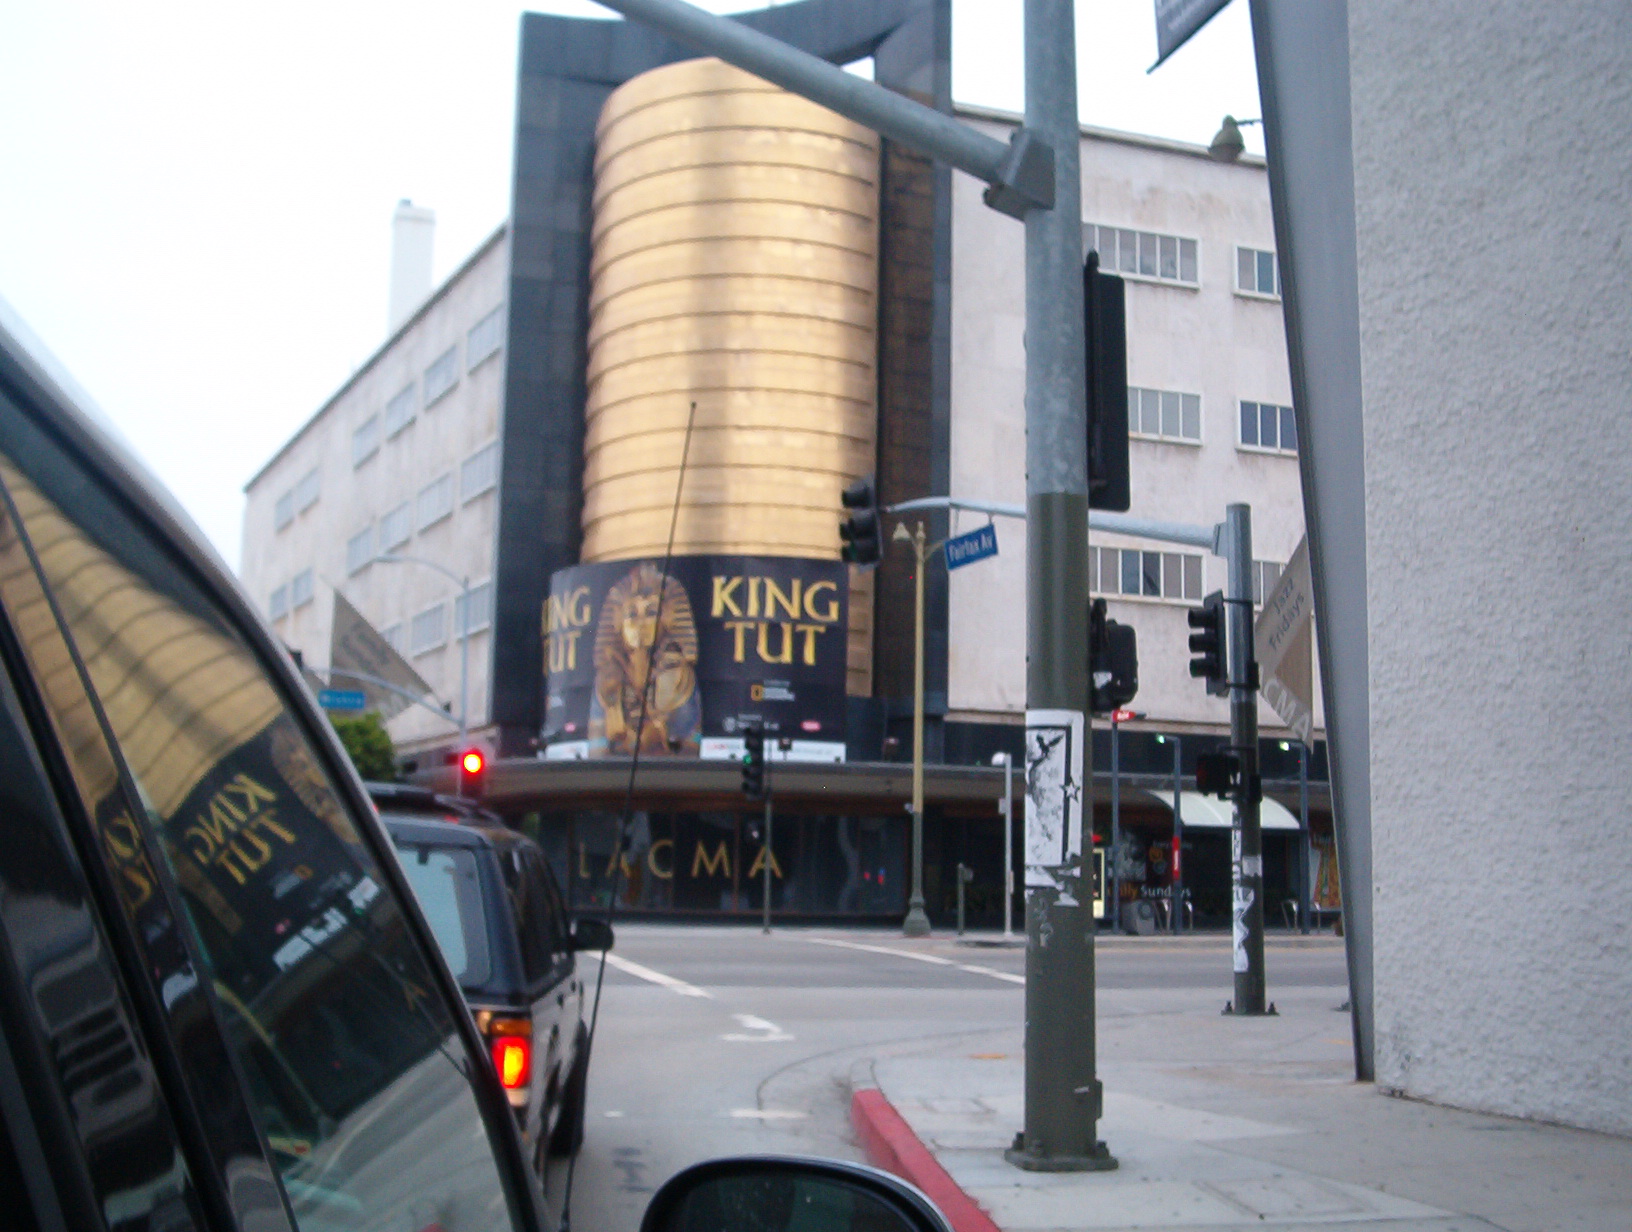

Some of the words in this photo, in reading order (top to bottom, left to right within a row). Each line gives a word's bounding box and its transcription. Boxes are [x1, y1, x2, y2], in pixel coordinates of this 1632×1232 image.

[710, 575, 840, 623] KING
[1268, 592, 1305, 651] Fridays
[723, 620, 827, 667] TUT
[578, 838, 784, 880] LACMA
[1140, 884, 1192, 900] Sundys
